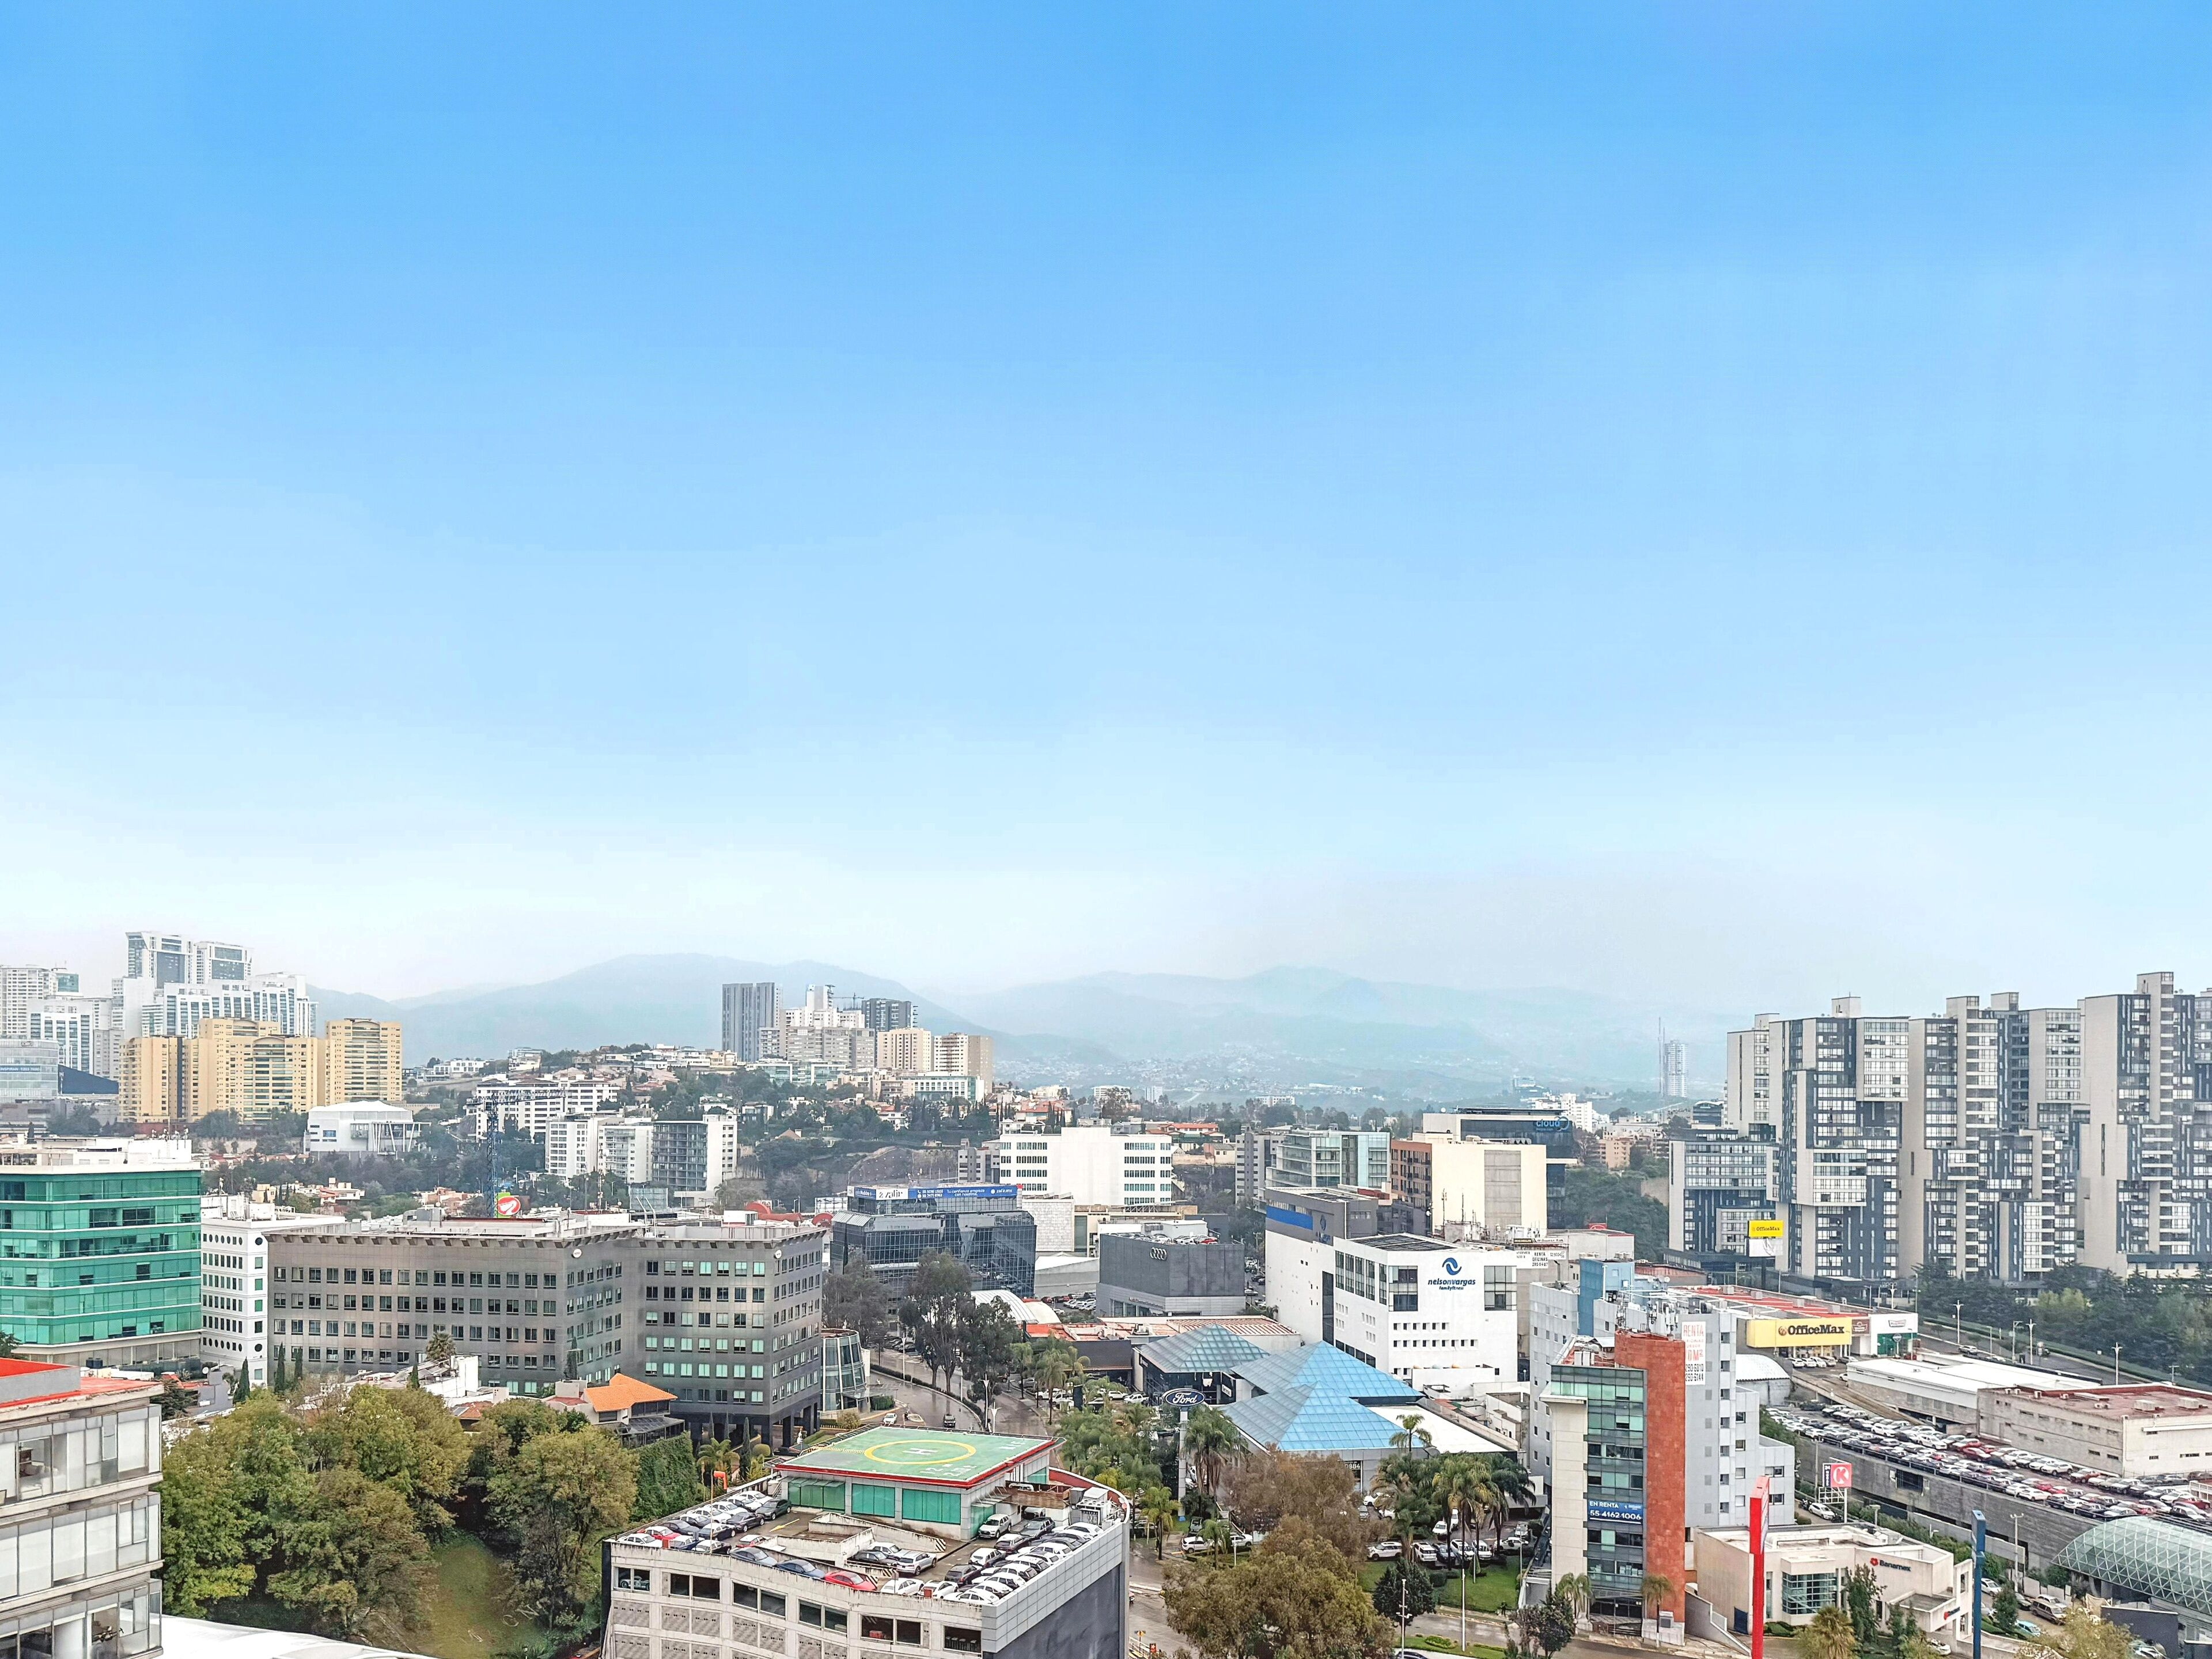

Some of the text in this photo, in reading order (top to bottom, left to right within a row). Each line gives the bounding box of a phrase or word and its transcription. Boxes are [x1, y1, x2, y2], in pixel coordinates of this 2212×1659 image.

[1427, 1278, 1476, 1286] nelsonvargas
[1683, 1324, 1704, 1337] RENTA
[1787, 1324, 1844, 1335] OfficeMax
[1172, 1392, 1198, 1404] Ford
[1879, 1559, 1911, 1571] Banamex
